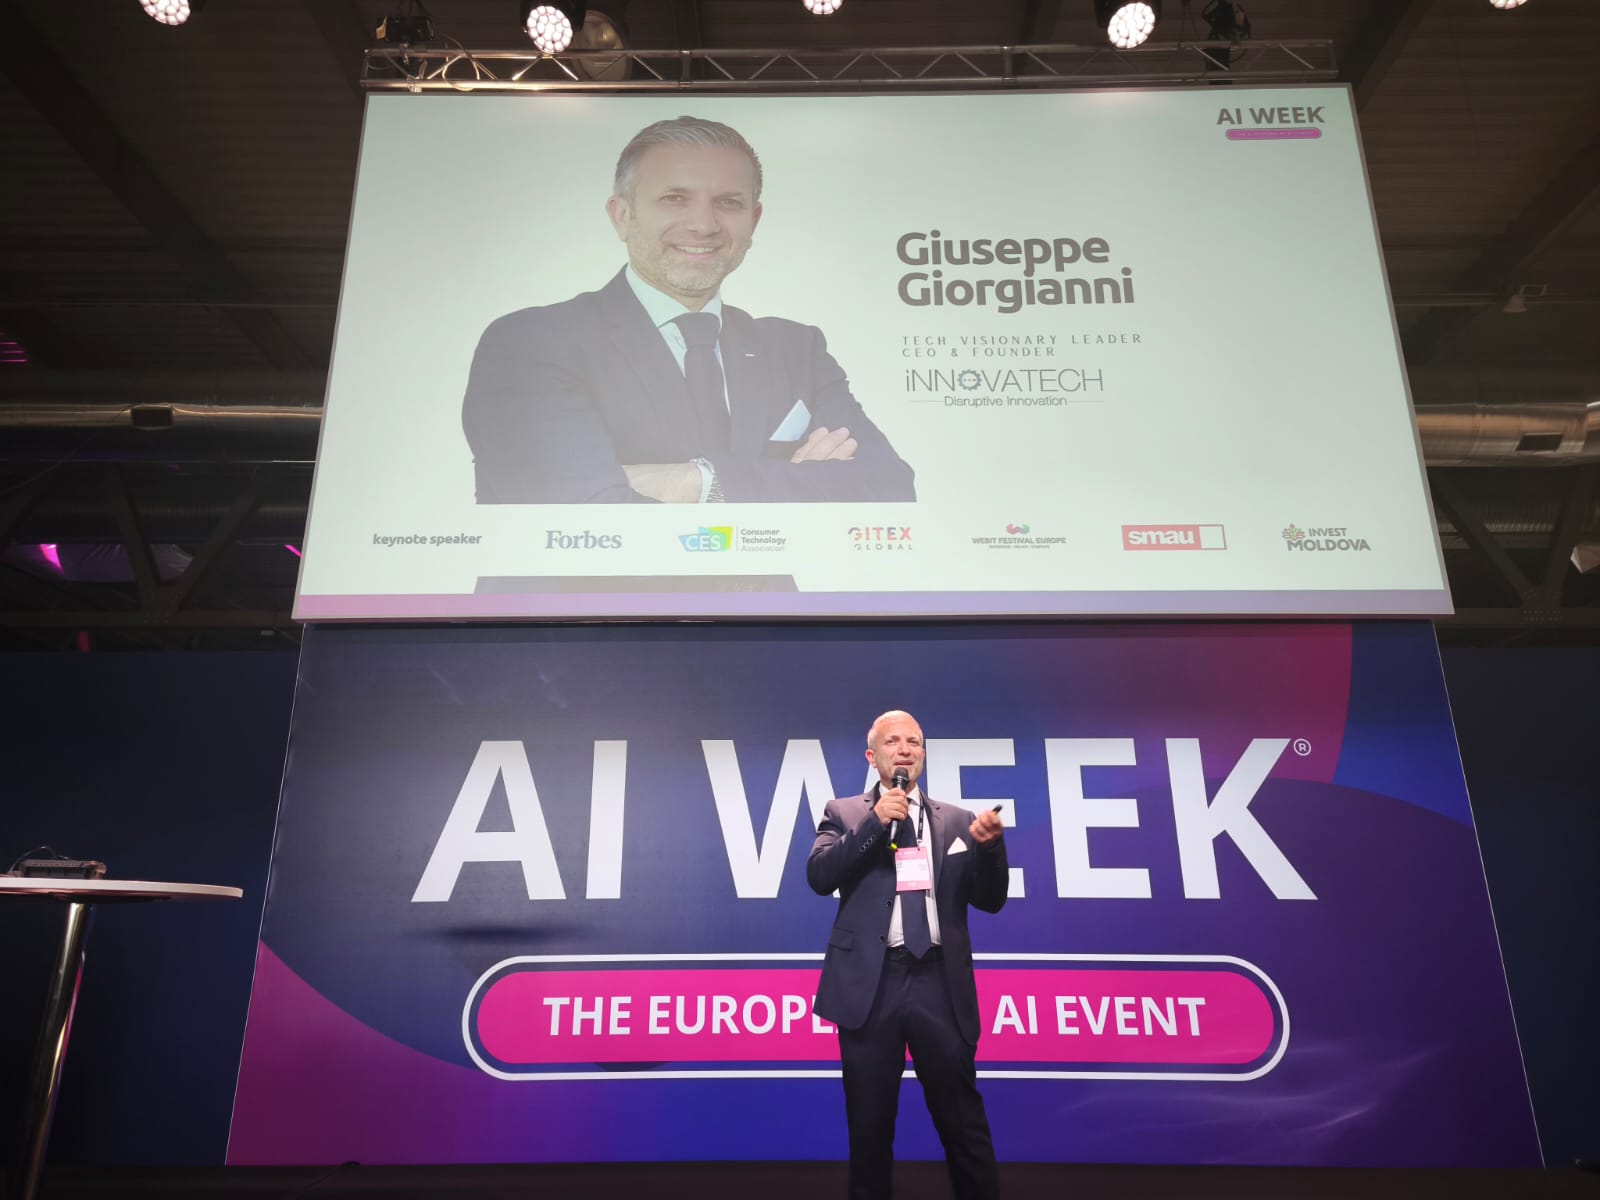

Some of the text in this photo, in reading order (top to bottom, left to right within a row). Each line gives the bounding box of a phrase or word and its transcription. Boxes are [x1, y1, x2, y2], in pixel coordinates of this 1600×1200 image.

[1216, 106, 1326, 125] AI WEEK
[896, 230, 1110, 272] Giuseppe
[898, 266, 1134, 313] Giorgianni
[902, 333, 1142, 345] TECH VISIONARY LEADER
[902, 346, 1056, 358] CEO & FOUNDER
[944, 395, 1068, 408] Disruptive Innovation
[372, 532, 482, 547] keynote speaker
[740, 528, 780, 536] Consumer
[848, 527, 912, 541] GITEX
[1128, 530, 1195, 545] smau
[1308, 527, 1348, 537] INVEST
[544, 530, 623, 550] Forbes
[685, 534, 721, 550] CES
[740, 536, 787, 545] Technology
[1286, 539, 1372, 551] MOLDOVA
[411, 740, 628, 903] AI
[700, 738, 1319, 900] WEEK
[543, 995, 631, 1036] THE
[992, 995, 1038, 1035] AI
[1056, 996, 1207, 1037] EVENT
